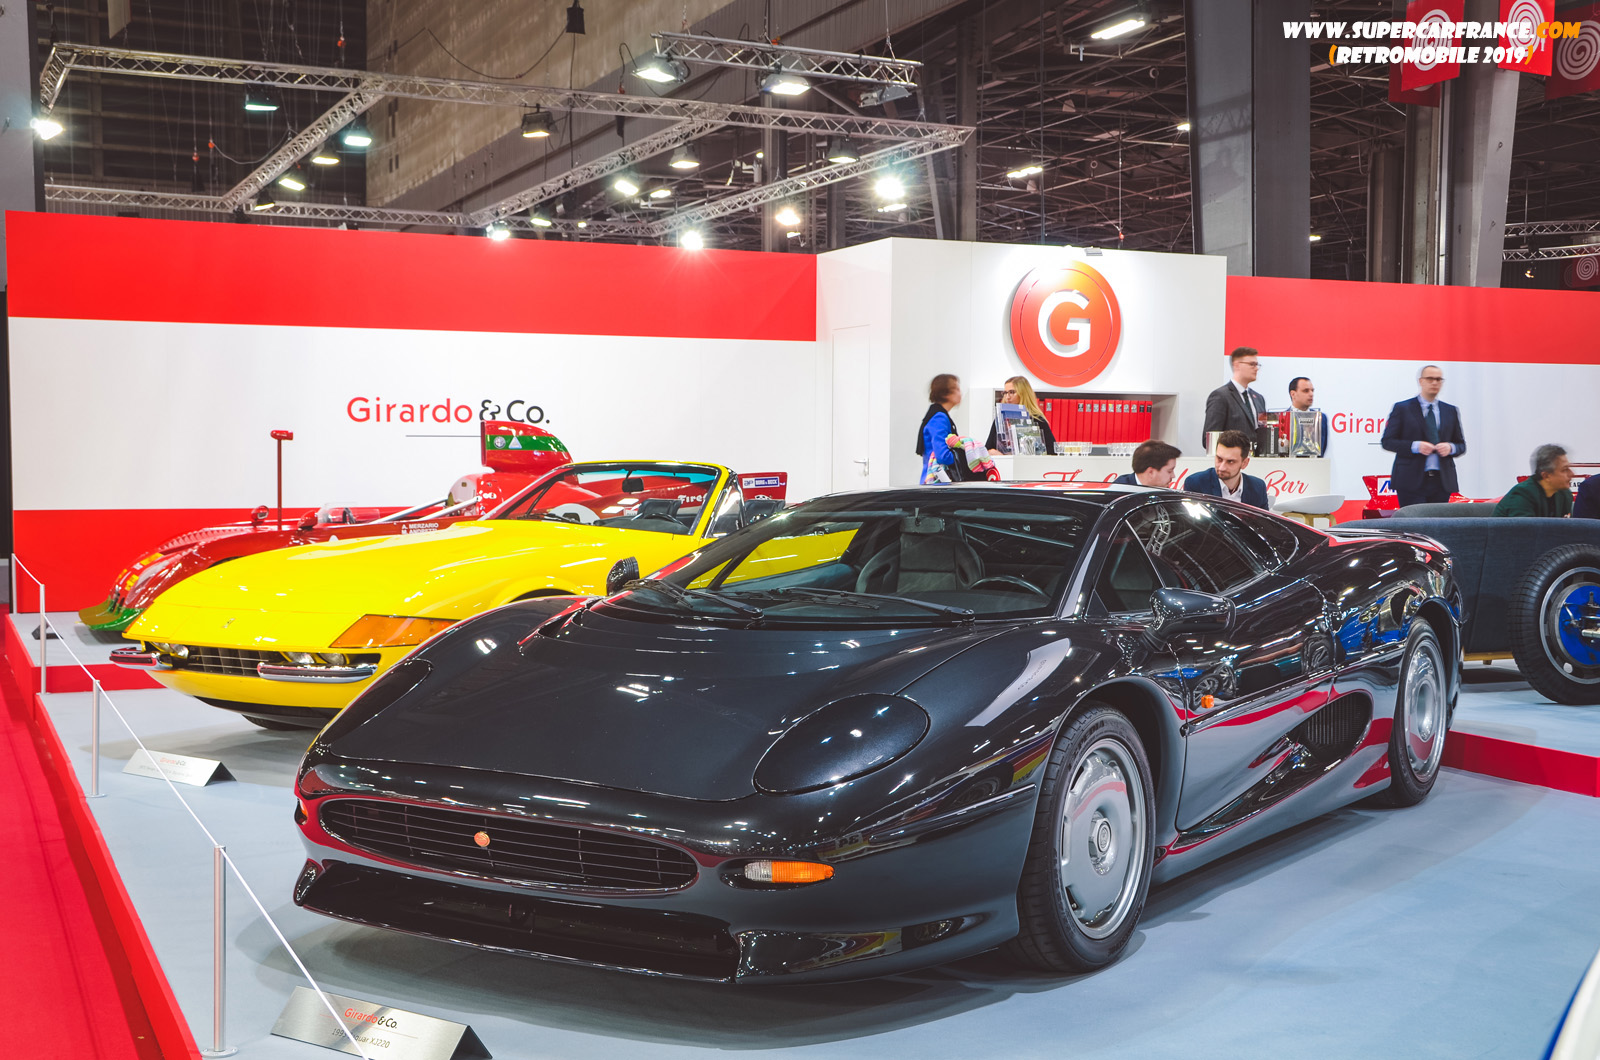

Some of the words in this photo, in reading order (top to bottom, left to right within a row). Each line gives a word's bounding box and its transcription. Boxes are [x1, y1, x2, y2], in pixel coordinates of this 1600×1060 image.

[347, 396, 473, 423] Girardo
[1332, 412, 1388, 434] Girar
[370, 1037, 391, 1048] XJ220
